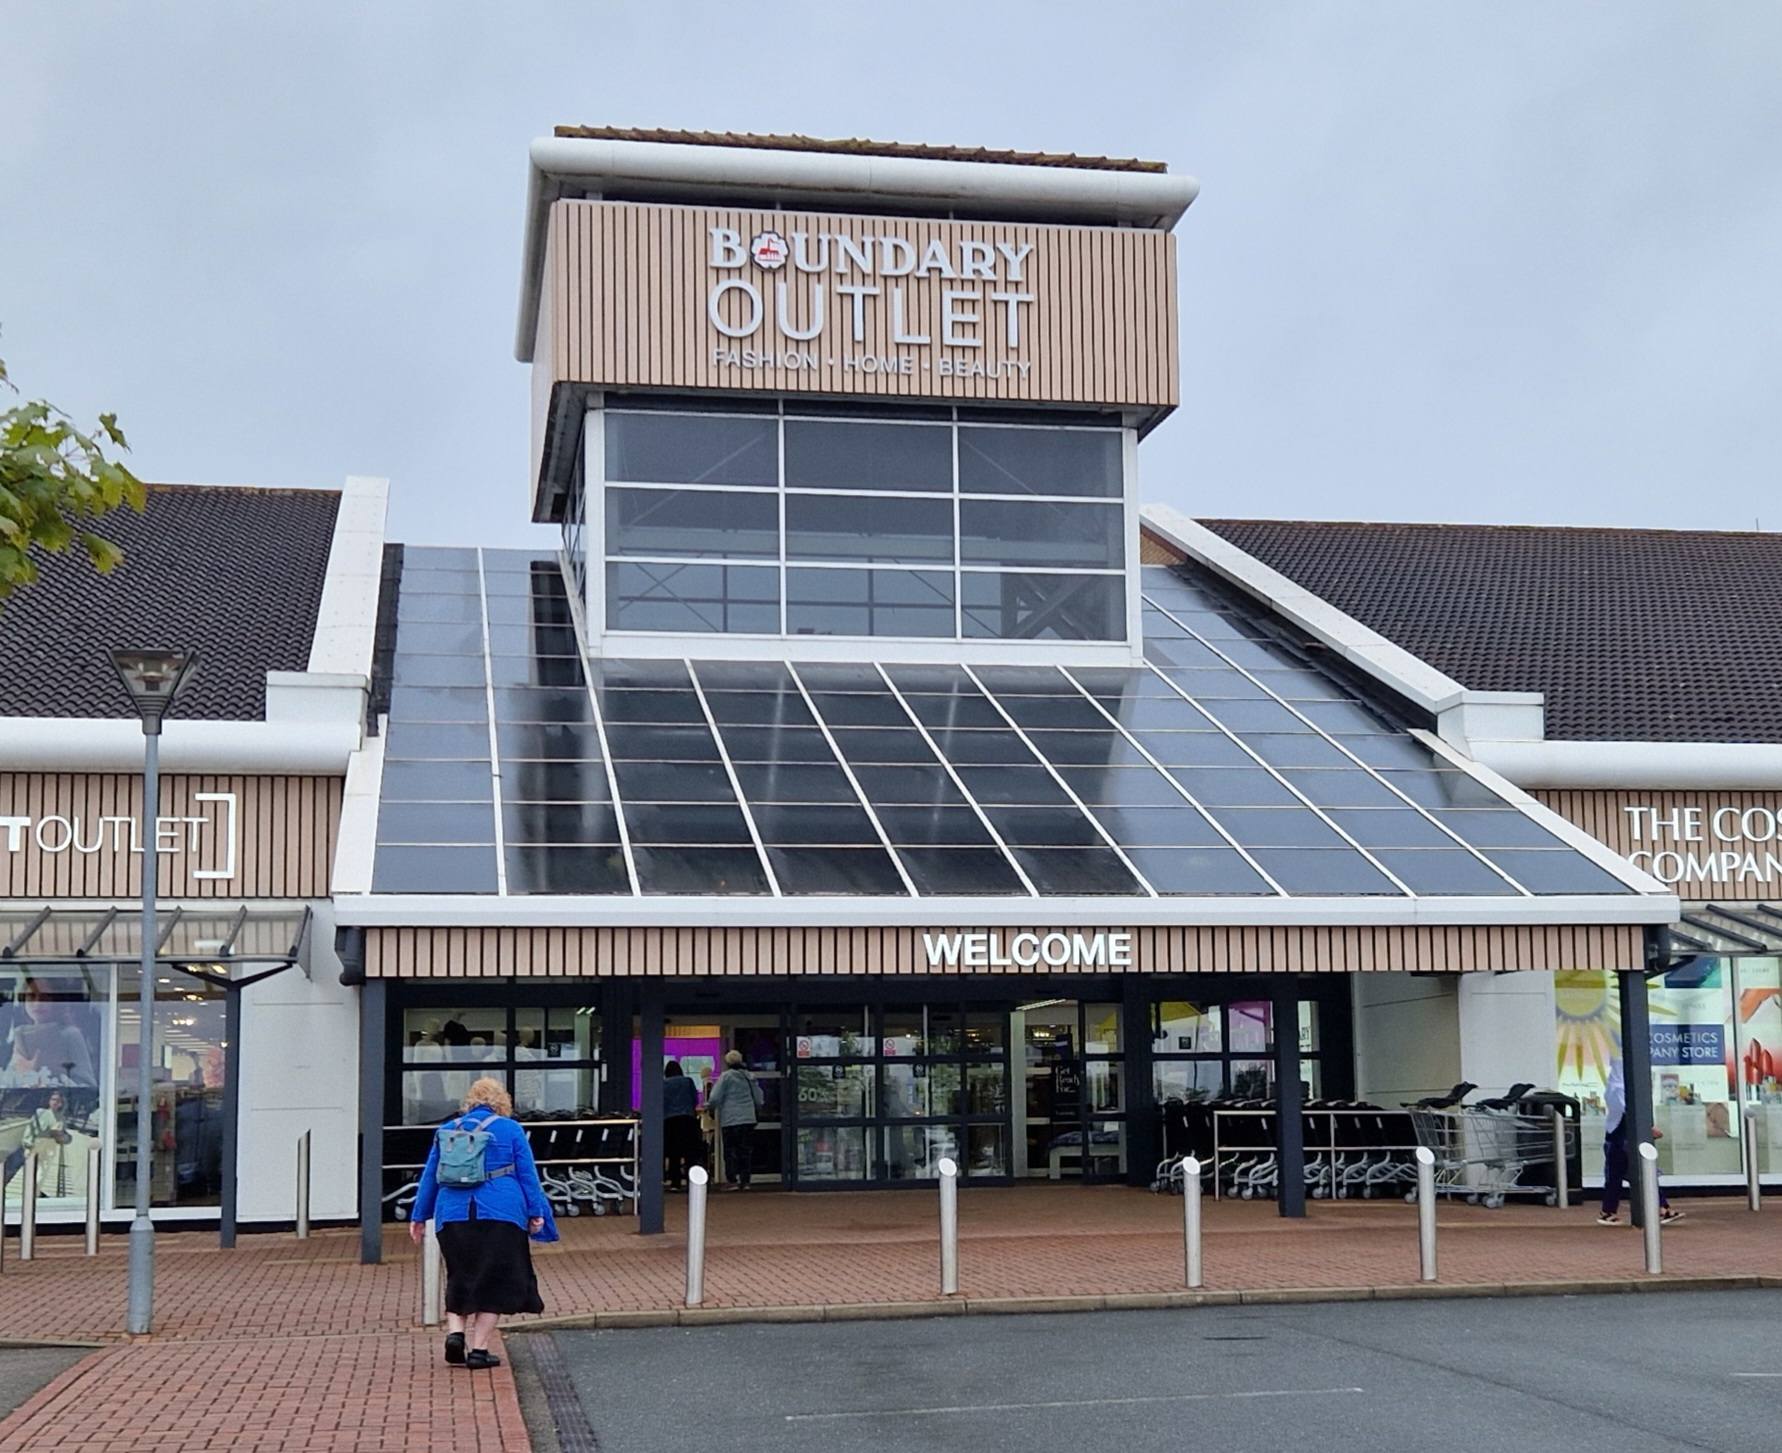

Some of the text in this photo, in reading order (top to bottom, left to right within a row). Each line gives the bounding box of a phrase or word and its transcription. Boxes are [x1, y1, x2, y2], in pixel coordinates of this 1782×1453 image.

[708, 278, 1035, 349] OUTLET
[712, 348, 1031, 379] FASHION HOME BEAUTY
[1624, 806, 1704, 841] THE
[922, 933, 1132, 967] WELCOME
[1681, 1046, 1719, 1059] STORE
